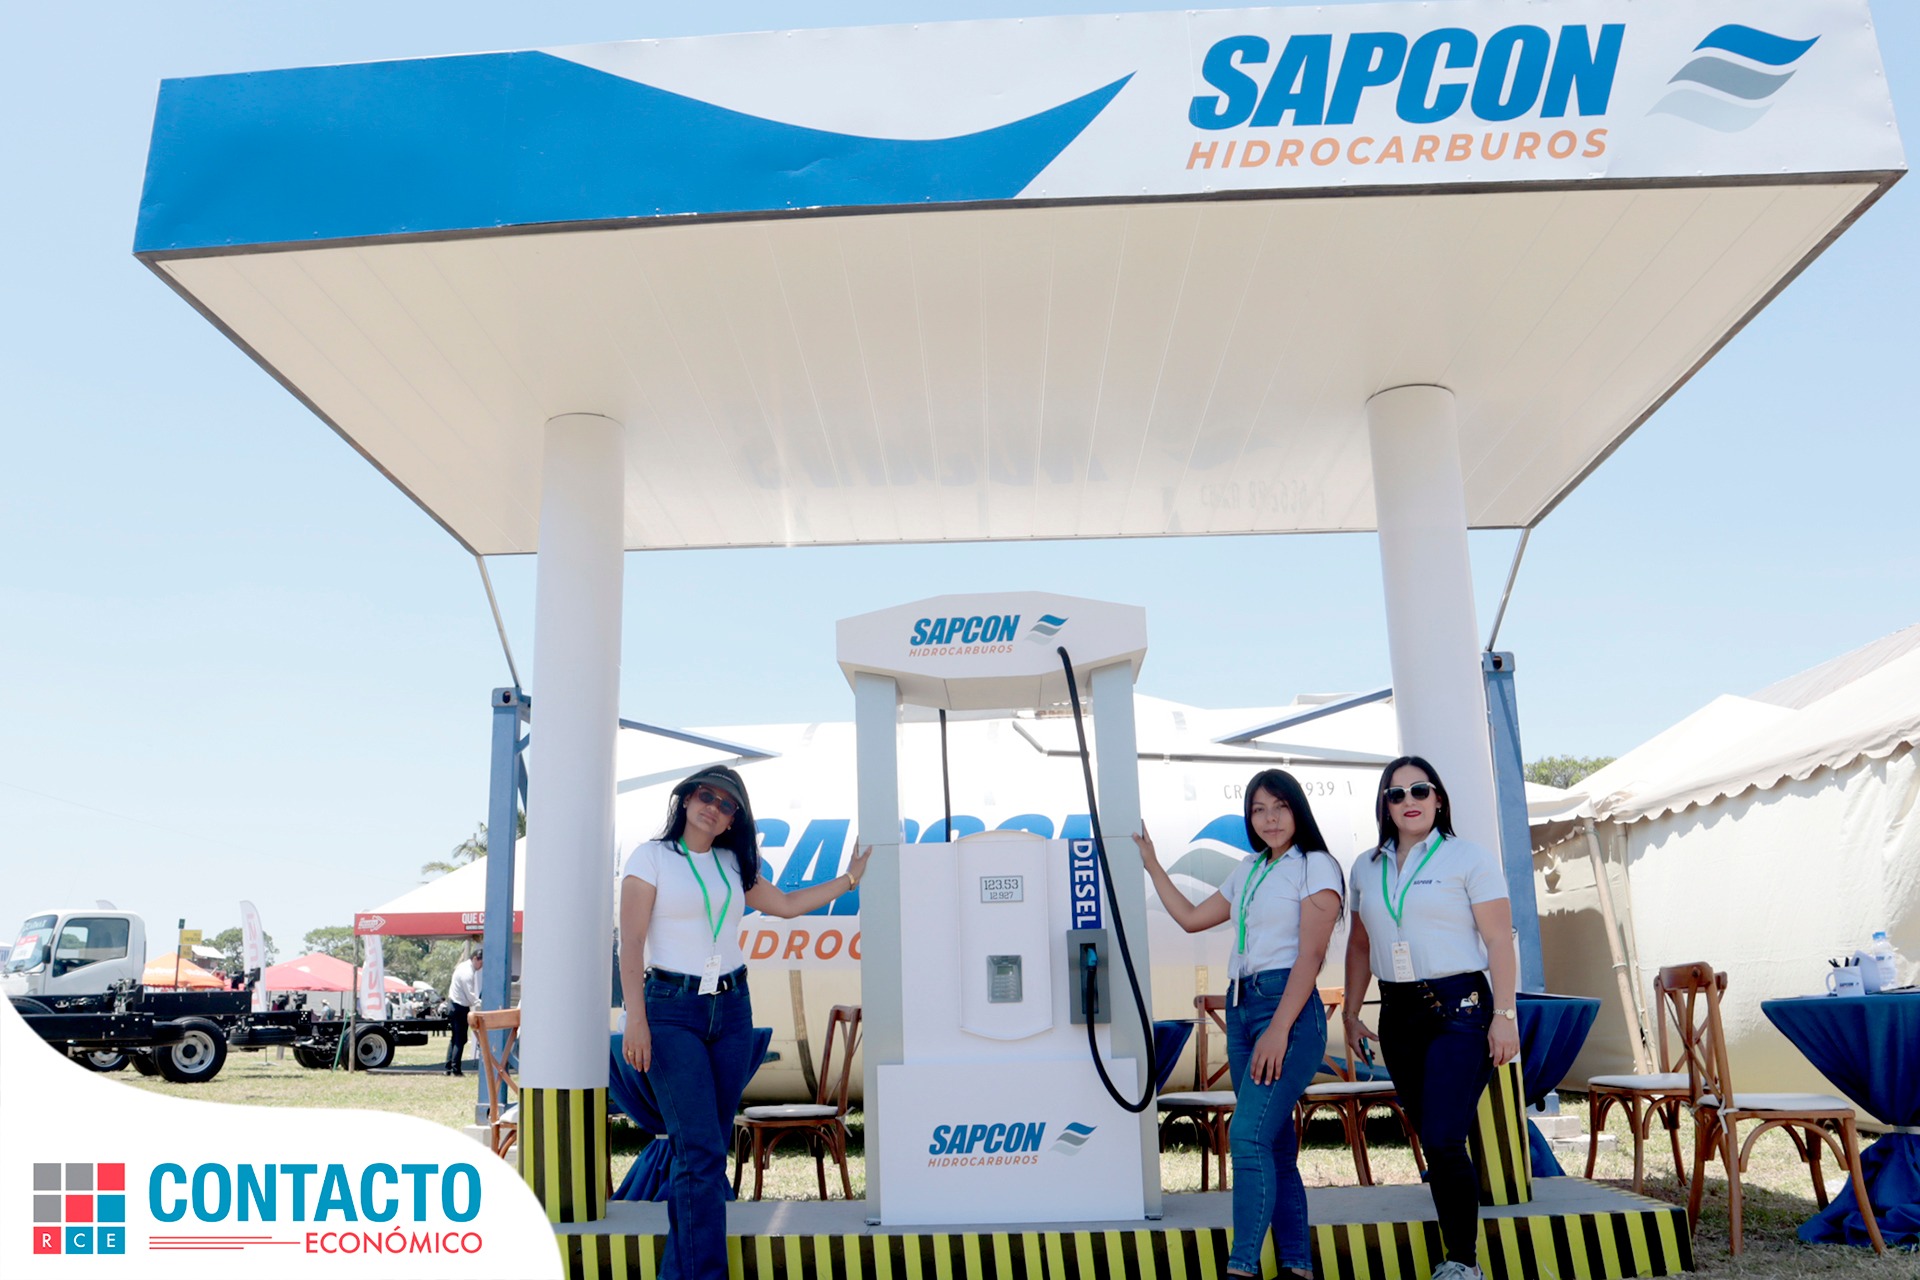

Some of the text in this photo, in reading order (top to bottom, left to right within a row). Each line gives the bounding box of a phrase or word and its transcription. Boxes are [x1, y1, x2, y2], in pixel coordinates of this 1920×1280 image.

[1187, 22, 1627, 132] SAPCON
[1186, 128, 1609, 170] HIDROCARBUROS
[910, 614, 1021, 647] SAPCON
[909, 644, 1014, 657] HIDROCARBUROS
[984, 878, 1019, 891] 123.53
[1073, 840, 1097, 929] DIESEL
[928, 1121, 1047, 1156] SAPCON
[927, 1154, 1040, 1168] HIDROCARBUROS
